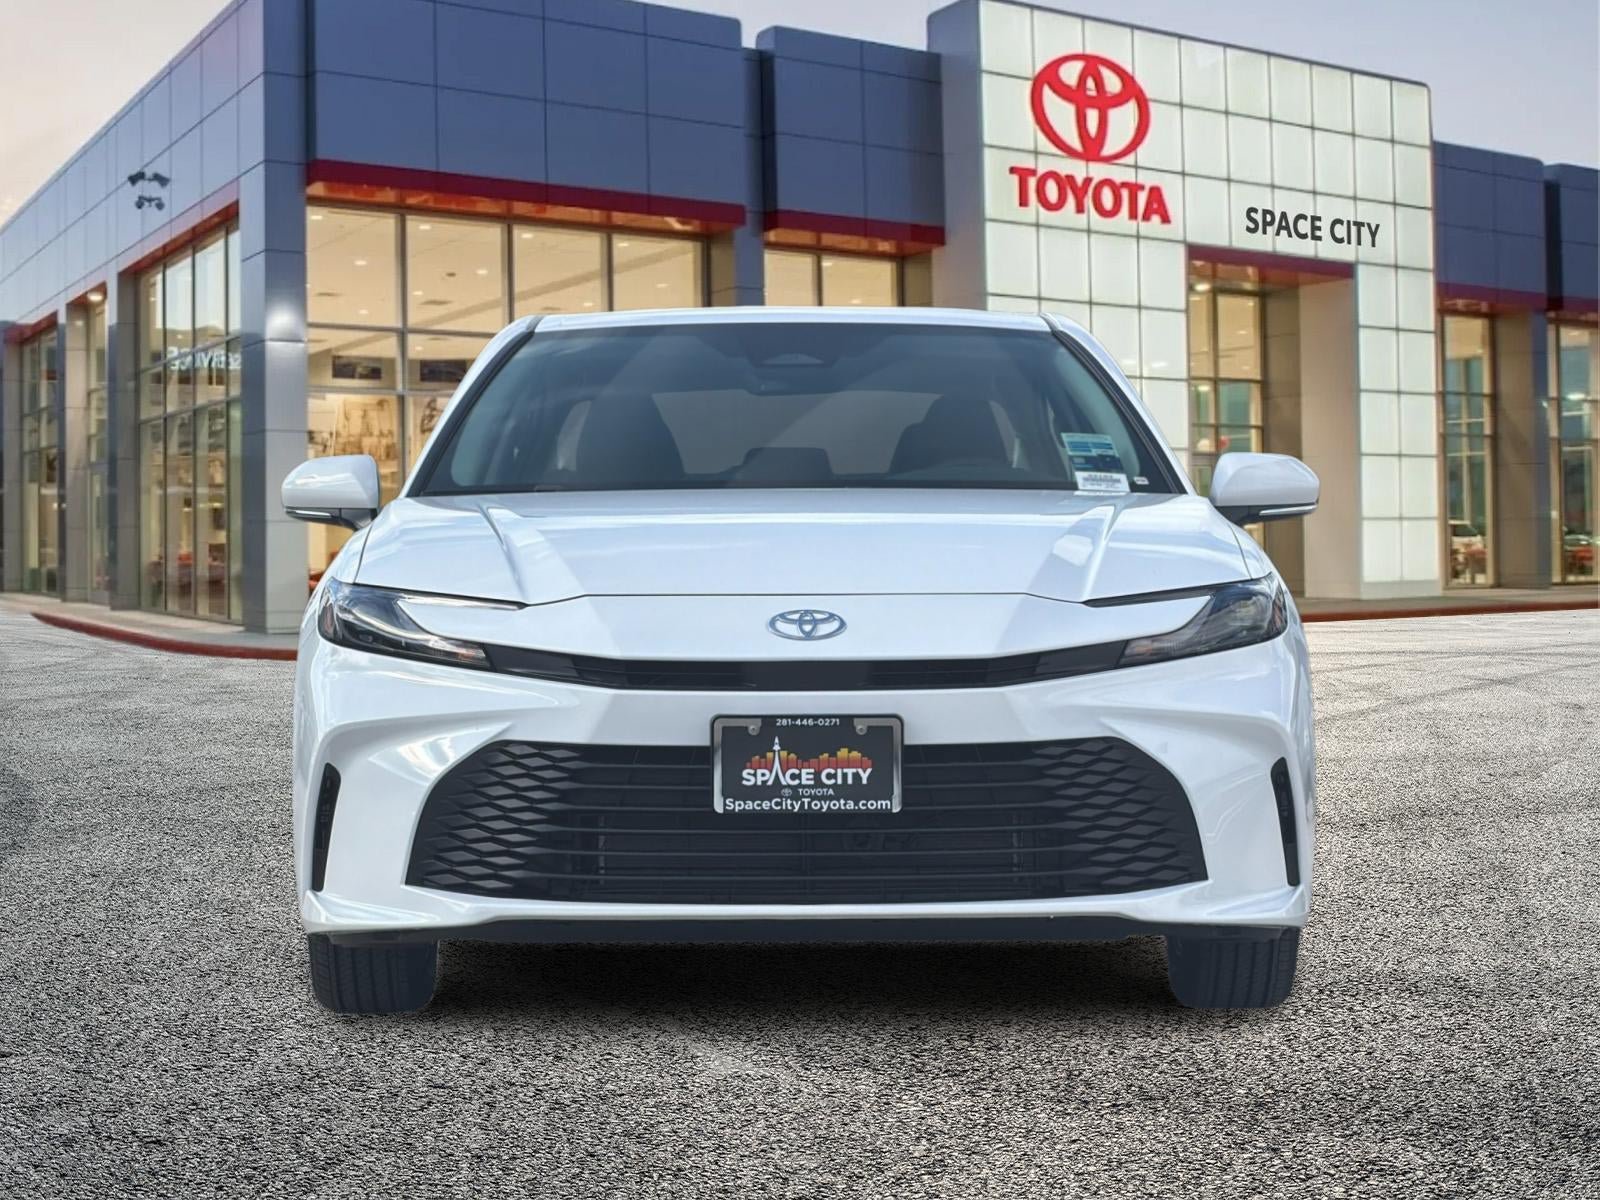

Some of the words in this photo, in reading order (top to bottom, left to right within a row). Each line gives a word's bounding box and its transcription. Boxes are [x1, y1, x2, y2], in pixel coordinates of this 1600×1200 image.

[1009, 166, 1172, 225] TOYOTA
[1245, 206, 1322, 242] SPACE
[1330, 219, 1380, 248] CITY
[776, 718, 840, 726] 281-446-0271
[741, 768, 815, 786] SPACE
[820, 768, 873, 785] CITY
[797, 788, 835, 796] TOYOTA
[725, 798, 892, 813] SpaceCityToyota.com
